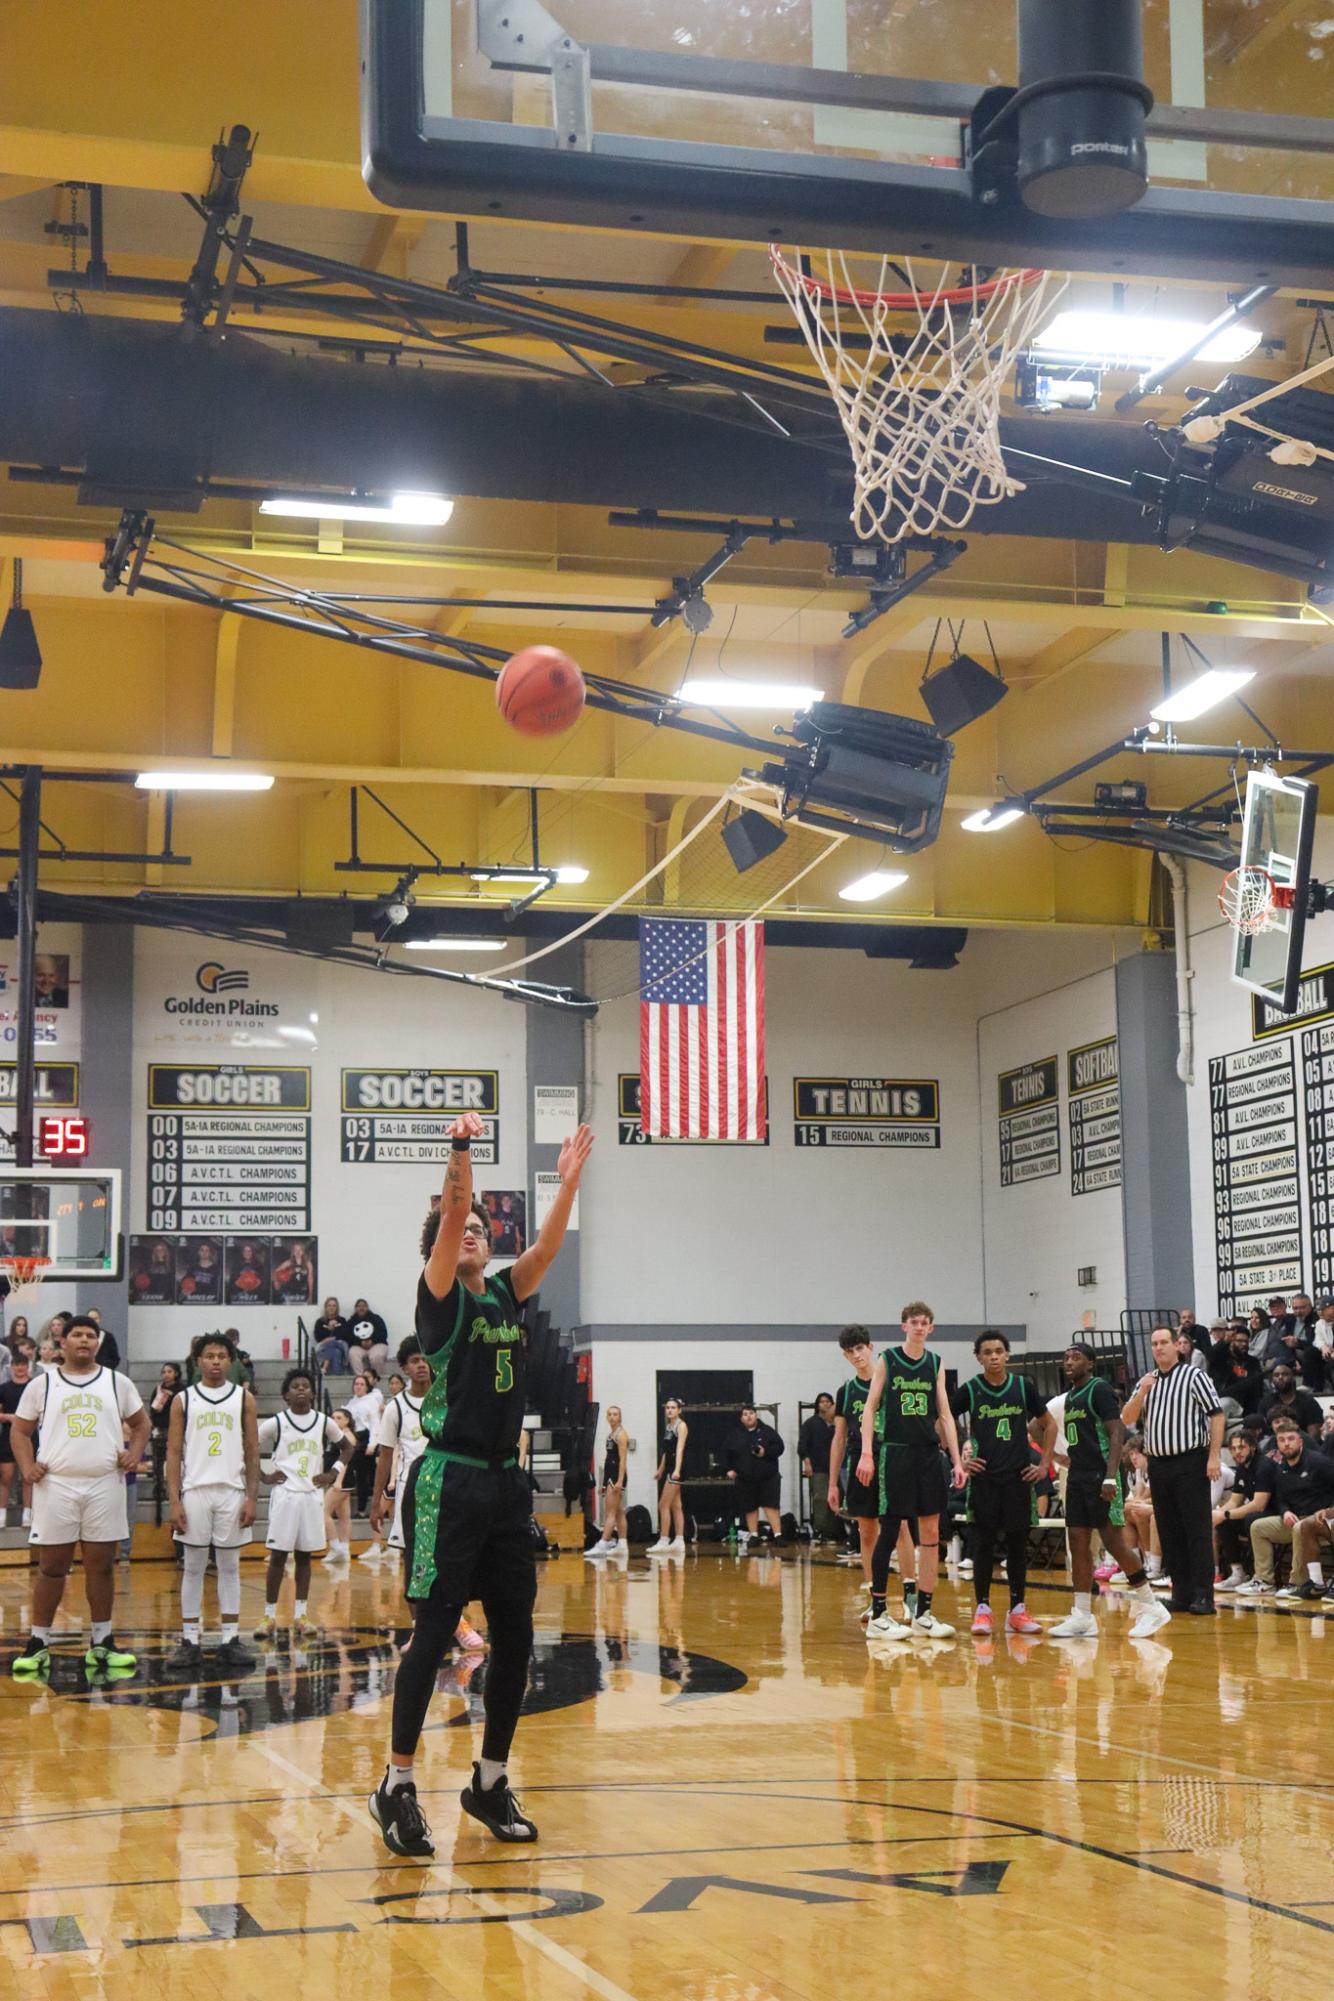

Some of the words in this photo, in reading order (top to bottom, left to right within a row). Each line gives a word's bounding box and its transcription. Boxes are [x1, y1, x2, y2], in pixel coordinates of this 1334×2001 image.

[164, 997, 226, 1015] Golden
[228, 998, 279, 1016] Plains
[179, 1018, 222, 1027] CREDIT
[226, 1019, 265, 1028] UNION
[1304, 1030, 1318, 1056] 04
[1211, 1058, 1224, 1082] 77
[1248, 1047, 1283, 1067] CHAMPIONS
[1305, 1059, 1320, 1084] 05
[177, 1073, 282, 1104] SOCCER
[358, 1075, 486, 1108] SOCCER
[851, 1080, 883, 1089] GIRLS
[1012, 1072, 1045, 1104] TENNIS
[1212, 1084, 1225, 1108] 77
[1228, 1082, 1256, 1099] REGIONAL
[1256, 1072, 1291, 1092] CHAMPIONS
[812, 1088, 921, 1116] TENNIS
[1307, 1087, 1321, 1112] 08
[1071, 1102, 1081, 1122] 02
[1213, 1111, 1225, 1134] 81
[1250, 1102, 1285, 1121] CHAMPIONS
[44, 1120, 85, 1153] 35
[152, 1116, 178, 1137] 00
[210, 1122, 253, 1132] REGIONAL
[254, 1122, 304, 1132] CHAMPIONS
[346, 1119, 370, 1138] 03
[411, 1123, 448, 1135] REGIONA
[623, 1124, 646, 1144] 73
[800, 1126, 820, 1145] 15
[831, 1130, 874, 1141] REGIONAL
[878, 1131, 930, 1143] CHAMPIONS
[1072, 1125, 1082, 1146] 03
[1309, 1115, 1322, 1140] 11
[152, 1139, 178, 1160] 03
[217, 1145, 257, 1155] REGIONAL
[258, 1145, 303, 1156] CHAMPIONS
[346, 1142, 370, 1161] 17
[1002, 1143, 1010, 1162] 17
[1215, 1137, 1227, 1160] 89
[1252, 1129, 1286, 1147] CHAMPIONS
[1309, 1144, 1324, 1168] 12
[1073, 1149, 1083, 1169] 17
[1087, 1147, 1107, 1161] REGIONAL
[152, 1162, 178, 1183] 06
[240, 1168, 297, 1179] CHAMPIONS
[1073, 1172, 1083, 1194] 24
[1215, 1163, 1228, 1187] 91
[1232, 1166, 1240, 1179] 5A
[1242, 1162, 1258, 1177] STATE
[1260, 1155, 1295, 1173] CHAMPIONS
[152, 1186, 178, 1206] 07
[239, 1191, 297, 1202] CHAMPIONS
[1310, 1172, 1326, 1197] 15
[1216, 1190, 1229, 1214] 93
[1232, 1190, 1260, 1206] REGIONAL
[1262, 1183, 1296, 1200] CHAMPIONS
[151, 1210, 178, 1230] 09
[239, 1214, 297, 1226] CHAMPIONS
[1312, 1201, 1327, 1225] 18
[1217, 1216, 1231, 1240] 96
[1233, 1217, 1261, 1232] REGIONAL
[1262, 1211, 1297, 1228] CHAMPIONS
[1218, 1243, 1231, 1267] 99
[1242, 1243, 1266, 1258] REGIONAL
[1266, 1239, 1298, 1255] CHAMPIONS
[1313, 1229, 1328, 1254] 18
[1219, 1270, 1233, 1294] 00
[1239, 1274, 1247, 1286] 5A
[1249, 1271, 1265, 1285] STATE
[1279, 1267, 1297, 1281] PLACE
[1314, 1258, 1329, 1283] 19
[1220, 1297, 1234, 1320] 00
[495, 1349, 514, 1392] 5
[61, 1393, 103, 1414] COLTS
[901, 1392, 928, 1416] 23
[67, 1413, 97, 1438] 52
[196, 1411, 234, 1431] COLTS
[996, 1418, 1012, 1441] 4
[208, 1432, 222, 1457] 2
